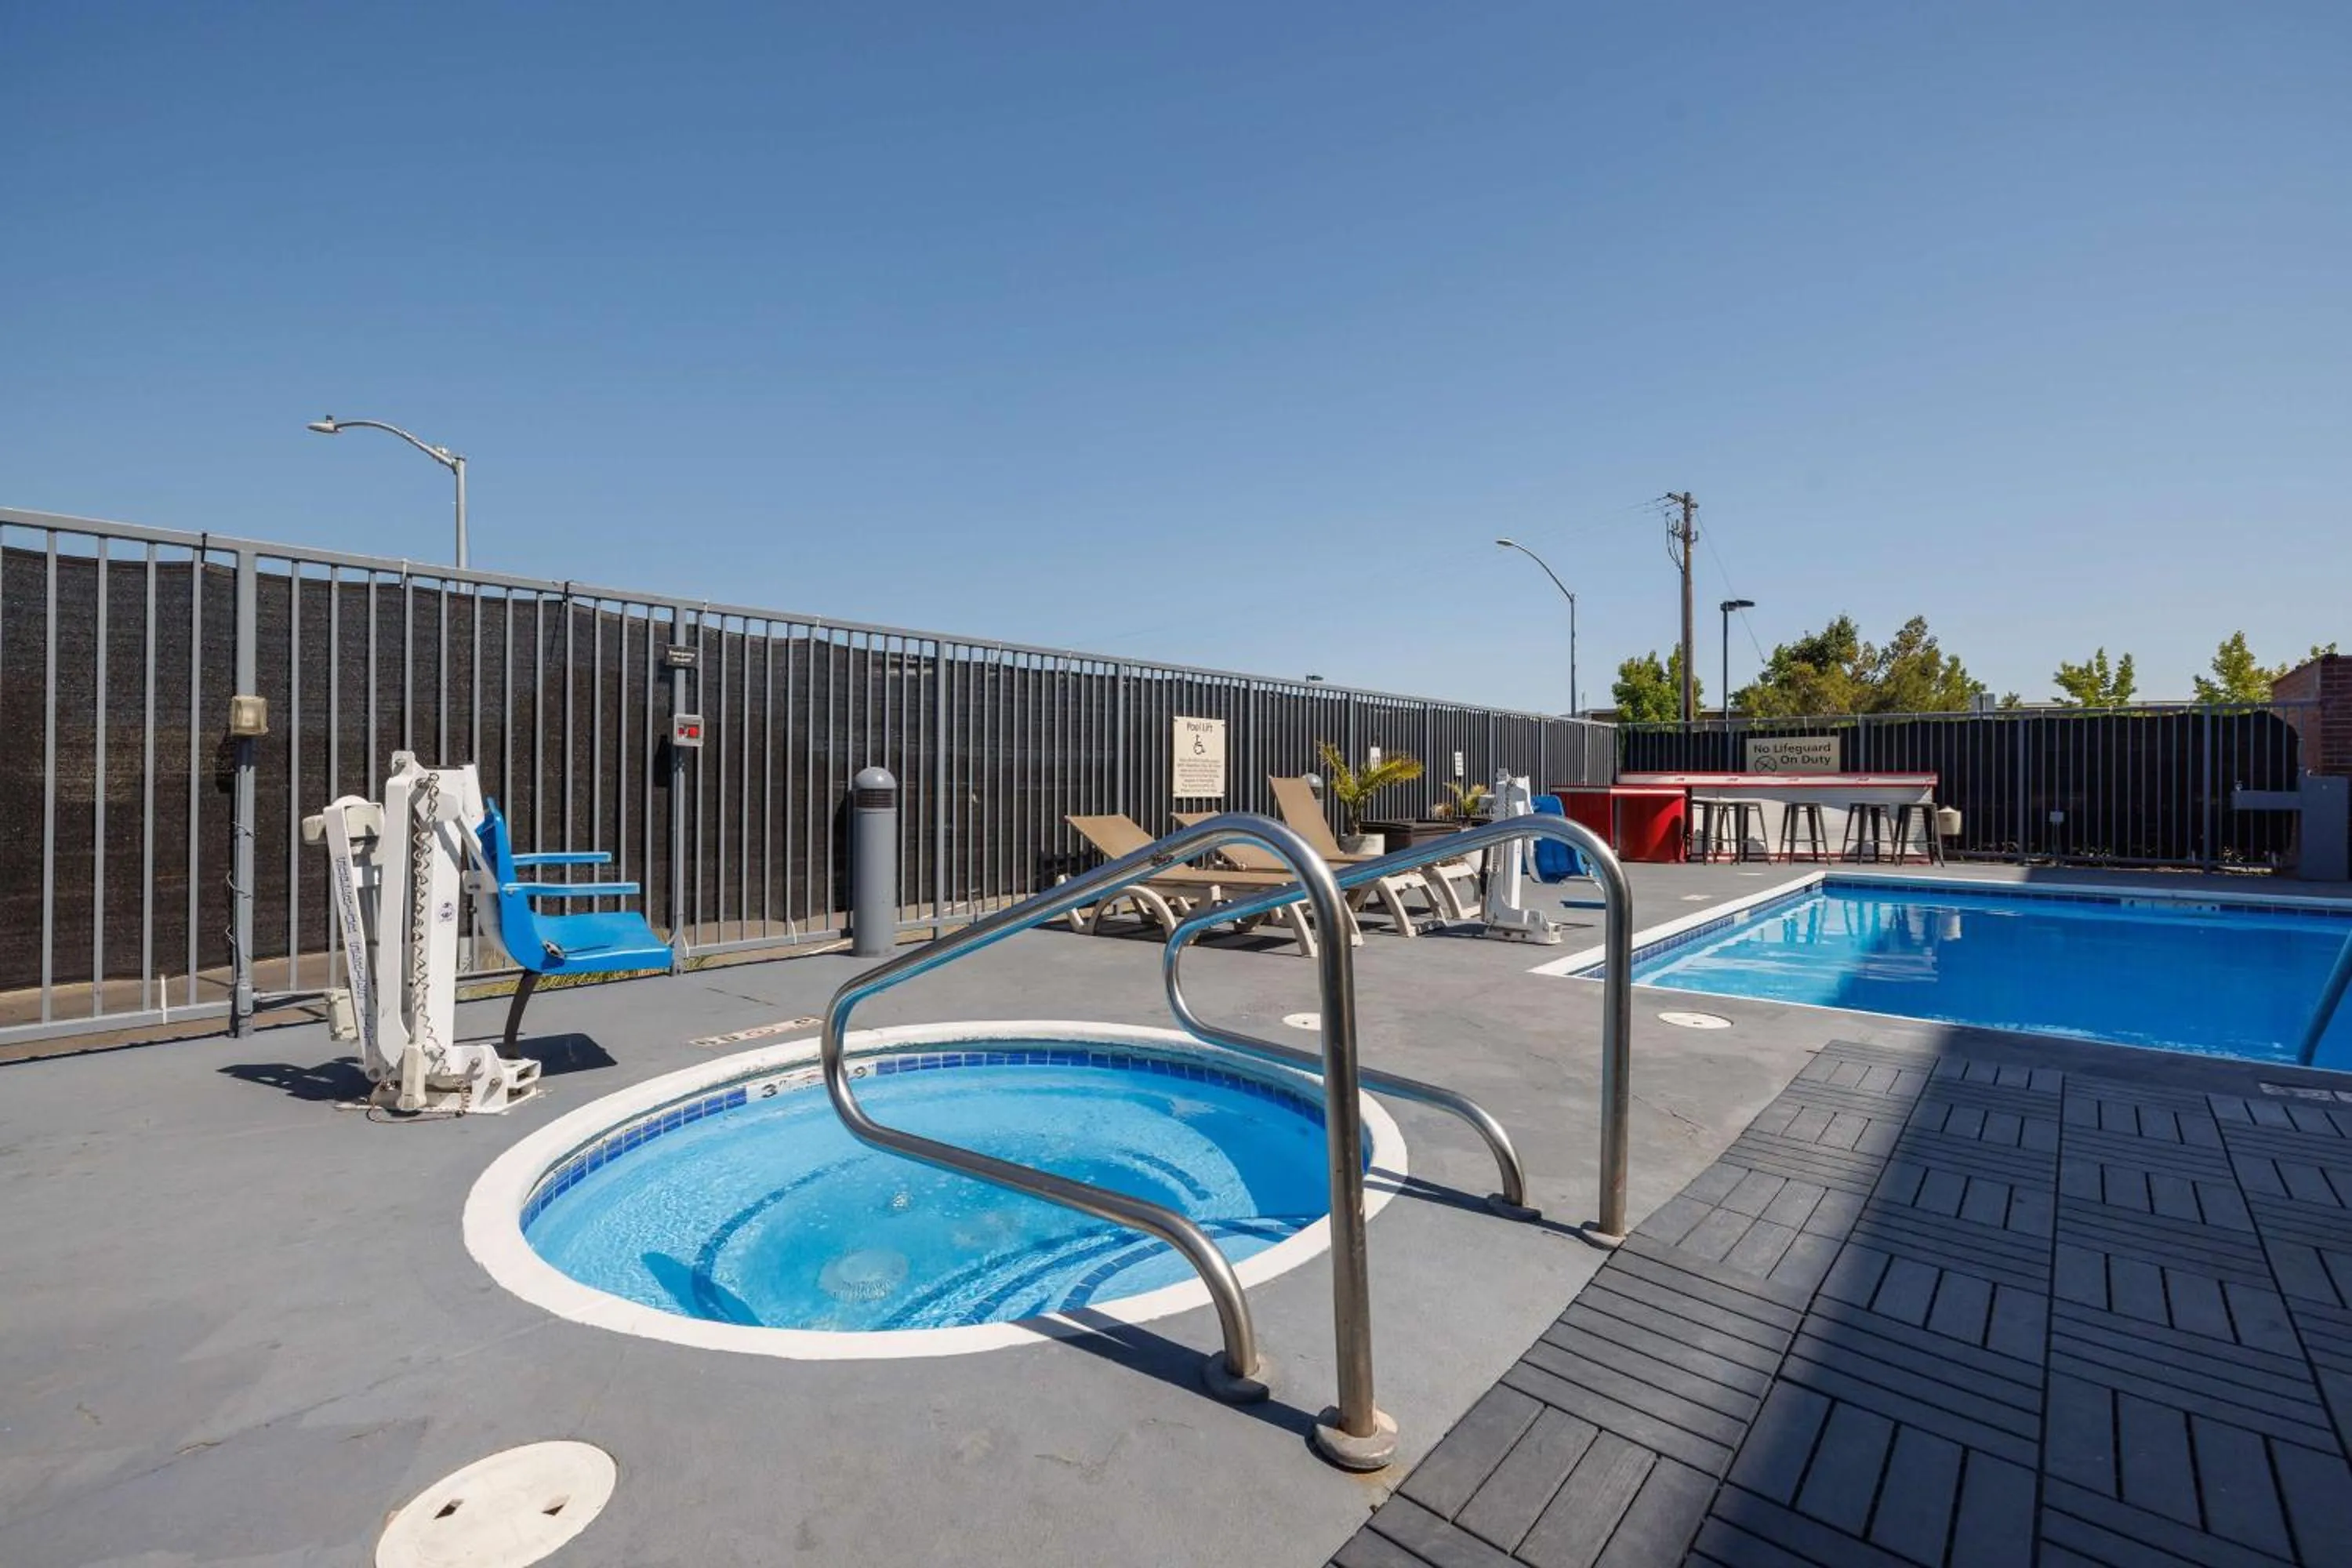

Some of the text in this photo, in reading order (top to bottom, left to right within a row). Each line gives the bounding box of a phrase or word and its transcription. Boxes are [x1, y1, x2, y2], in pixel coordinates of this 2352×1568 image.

[1186, 721, 1201, 731] Pool
[1754, 742, 1831, 754] No Lifeguard
[1780, 755, 1831, 765] On Duty
